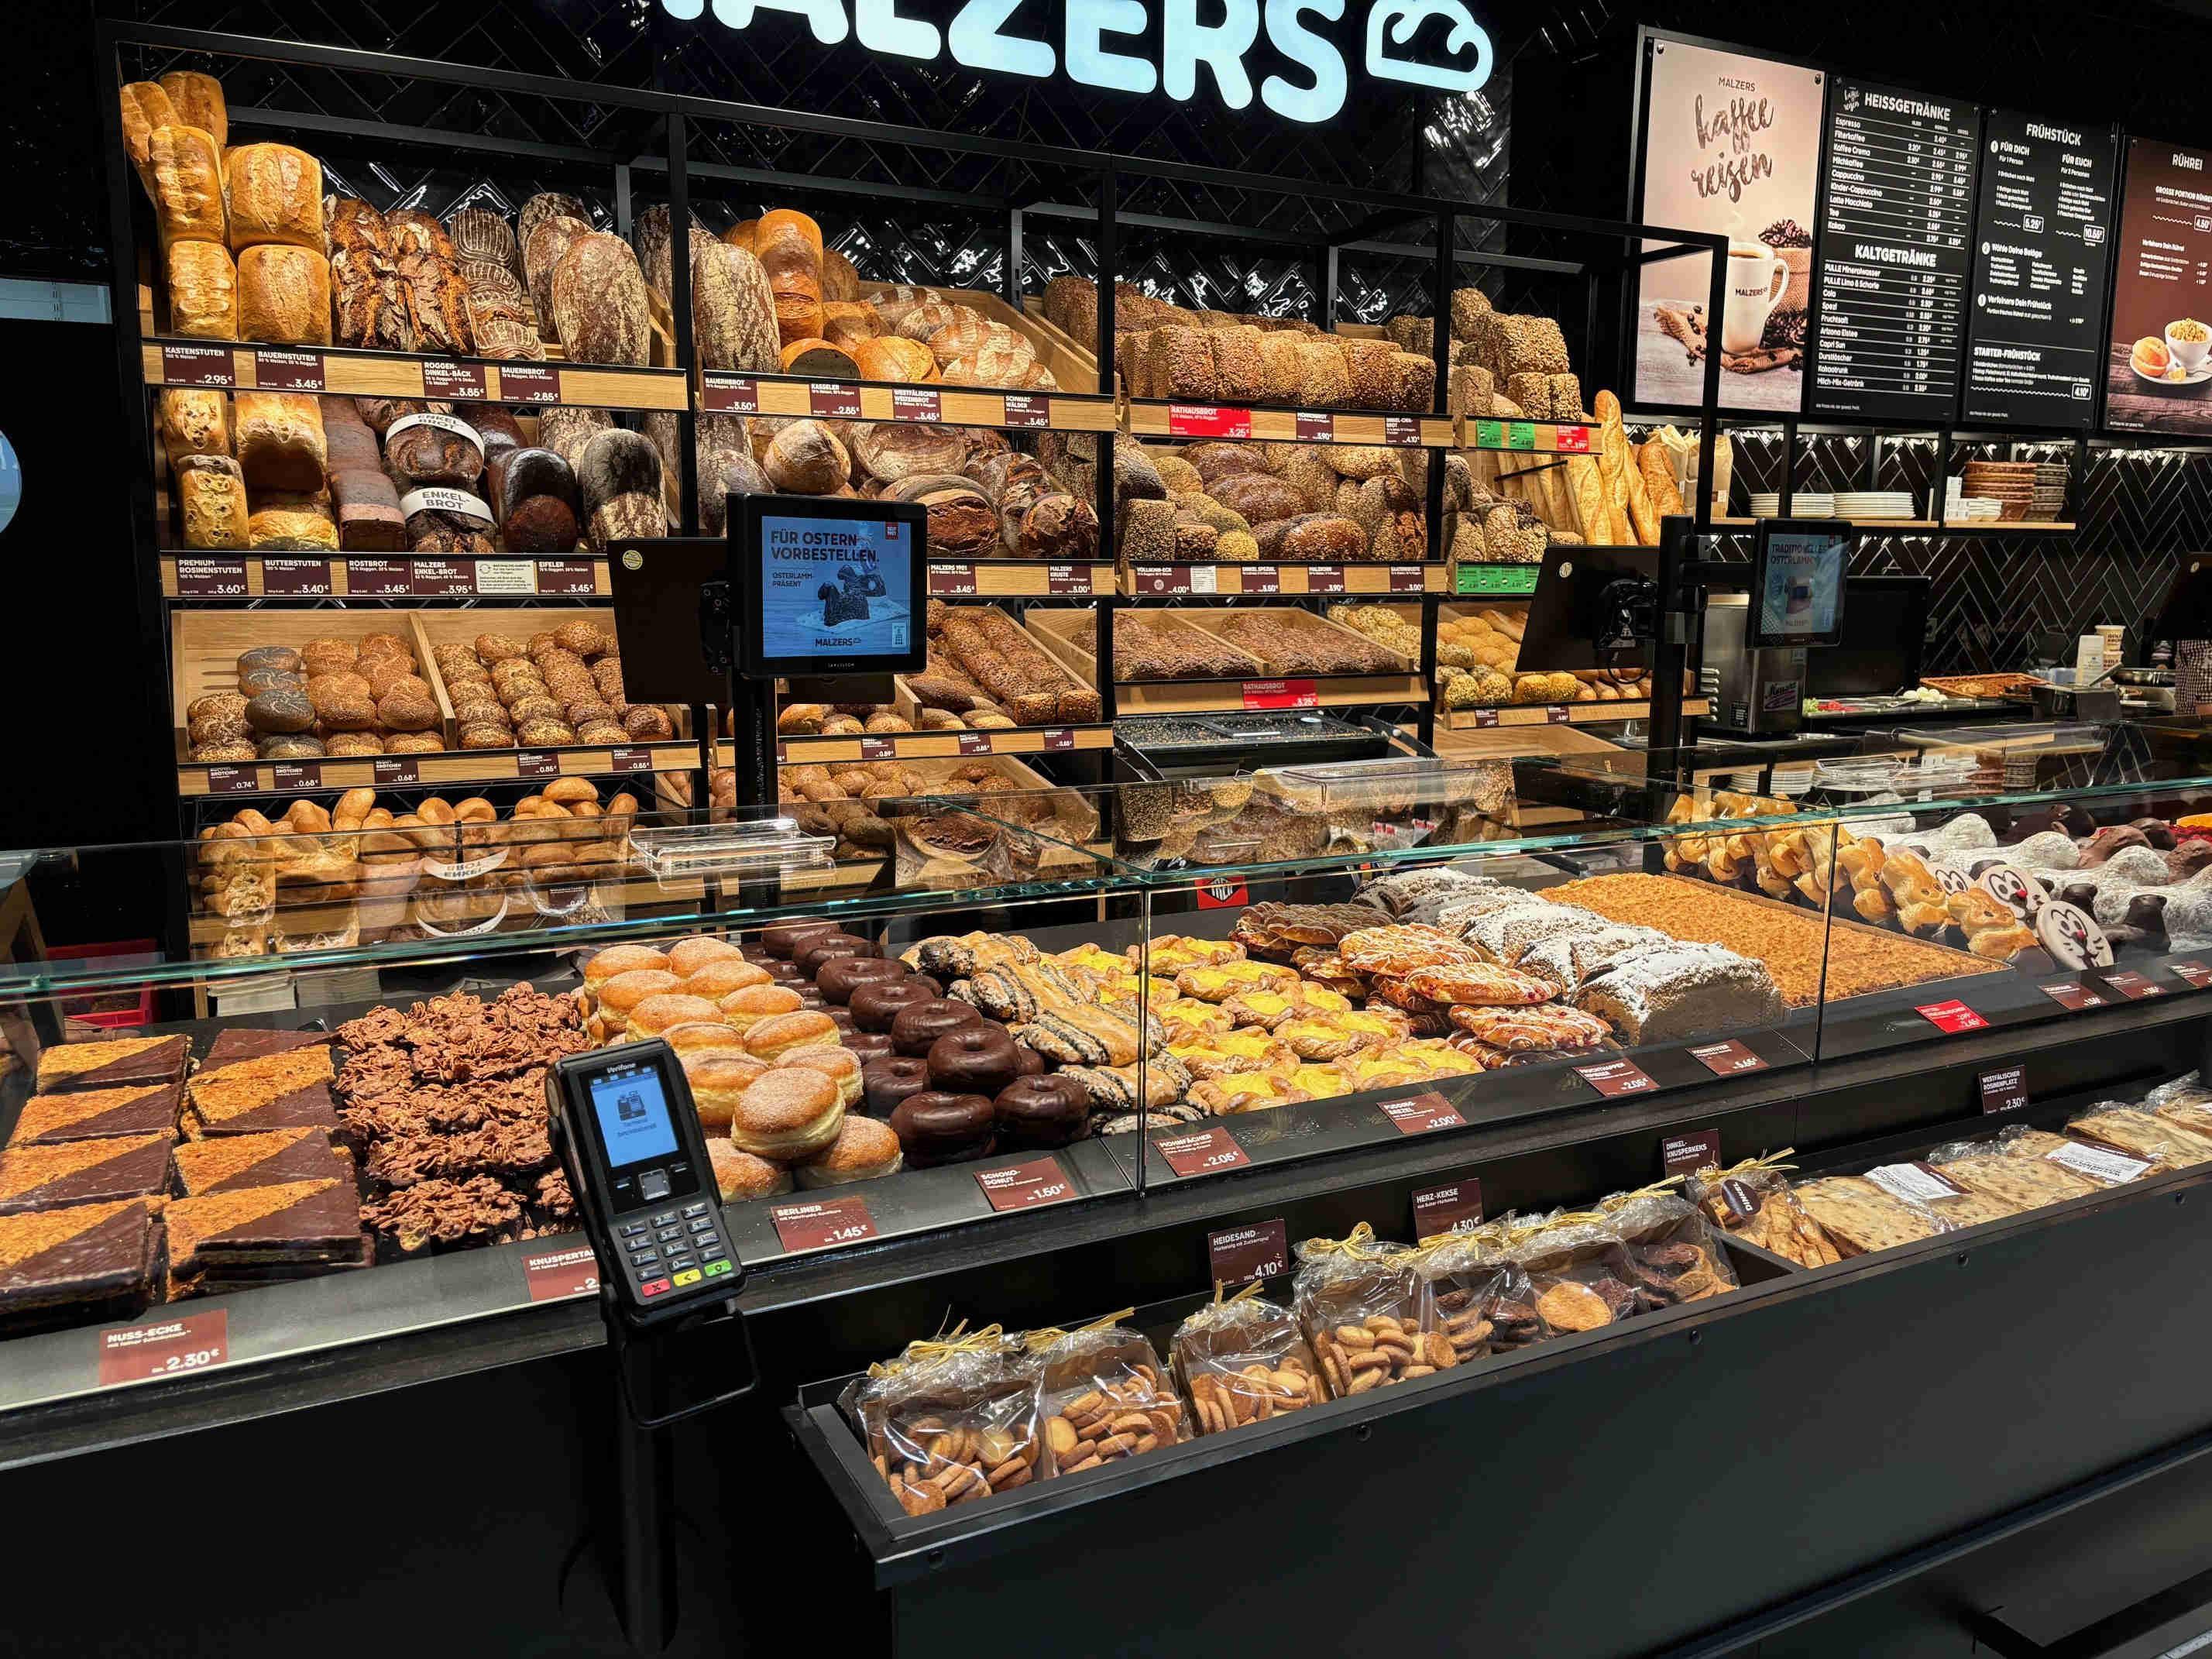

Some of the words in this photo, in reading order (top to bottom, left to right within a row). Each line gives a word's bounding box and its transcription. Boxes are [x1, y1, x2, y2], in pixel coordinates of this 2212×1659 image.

[662, 0, 1348, 123] LZERS
[1718, 76, 1755, 91] MALZERS
[1864, 92, 1950, 121] HEISSGETRÄNKE
[1695, 94, 1774, 154] kaffee
[1836, 117, 1860, 128] Espresso
[1834, 130, 1865, 143] Filterkaffee
[2026, 123, 2082, 146] FRÜHSTÜCK
[1833, 143, 1851, 153] Kaffee
[2000, 140, 2013, 153] FÜR
[2014, 144, 2030, 156] DICH
[1832, 156, 1864, 168] Milchkaffee
[2062, 153, 2075, 165] FÜR
[2075, 156, 2092, 168] EUCH
[2172, 153, 2203, 171] RÜHREI
[1691, 152, 1772, 203] reisen
[1832, 169, 1865, 181] Cappuccino
[1831, 182, 1883, 197] Kinder-Cappuccino
[1829, 208, 1839, 217] Tee
[1854, 244, 1937, 267] KALTGETRÄNKE
[1842, 264, 1881, 277] Mineralwasser
[1859, 280, 1880, 290] Schorle
[1735, 287, 1764, 297] MALZERS
[1822, 289, 1836, 298] Cola
[1822, 301, 1838, 311] Spezi
[1821, 314, 1849, 325] Fruchtsaft
[1820, 327, 1841, 338] Arizona
[1819, 339, 1836, 350] Capri
[1836, 341, 1846, 350] Sun
[165, 346, 225, 357] KASTENSTUTEN
[257, 351, 316, 362] BAUERNSTUTEN
[1973, 346, 2042, 362] STARTER-FRÜHSTÜCK
[501, 366, 546, 375] BAUERNBROT
[204, 374, 233, 385] 2.95€
[294, 378, 323, 389] 3.45€
[705, 377, 745, 386] BAUERNBROT
[894, 389, 938, 397] WESTFÄLISCHES
[1170, 405, 1218, 416] RATHAUSBROT
[419, 418, 455, 430] BROT
[422, 490, 470, 503] ENKEL-
[426, 499, 465, 510] BROT
[770, 527, 799, 544] FÜR
[802, 531, 857, 547] OSTERN
[770, 546, 881, 562] VORBESTELLEN.
[302, 584, 329, 594] 3.40€
[815, 637, 853, 647] MALZERS
[1242, 682, 1286, 690] RATHAUSBROT
[606, 1062, 637, 1074] Verifone
[1981, 1070, 2021, 1084] WESTFÄLISCHER
[1983, 1077, 2018, 1091] ROSINENPLATZ
[1666, 1140, 1688, 1150] DINKEL-
[1667, 1143, 1708, 1159] KNUSPERKEKS
[981, 1170, 1022, 1180] SCHOKO-
[984, 1176, 1015, 1186] DONUT
[1416, 1187, 1459, 1204] HERZ-KEKSE
[1733, 1181, 1753, 1211] DINKEL
[776, 1204, 823, 1217] BERLINER
[833, 1224, 868, 1240] 1.45€
[1213, 1230, 1257, 1245] HEIDESAND
[1255, 1260, 1283, 1277] 4.10€
[107, 1323, 184, 1343] NUSS-ECKE
[167, 1348, 220, 1371] 2.30€
